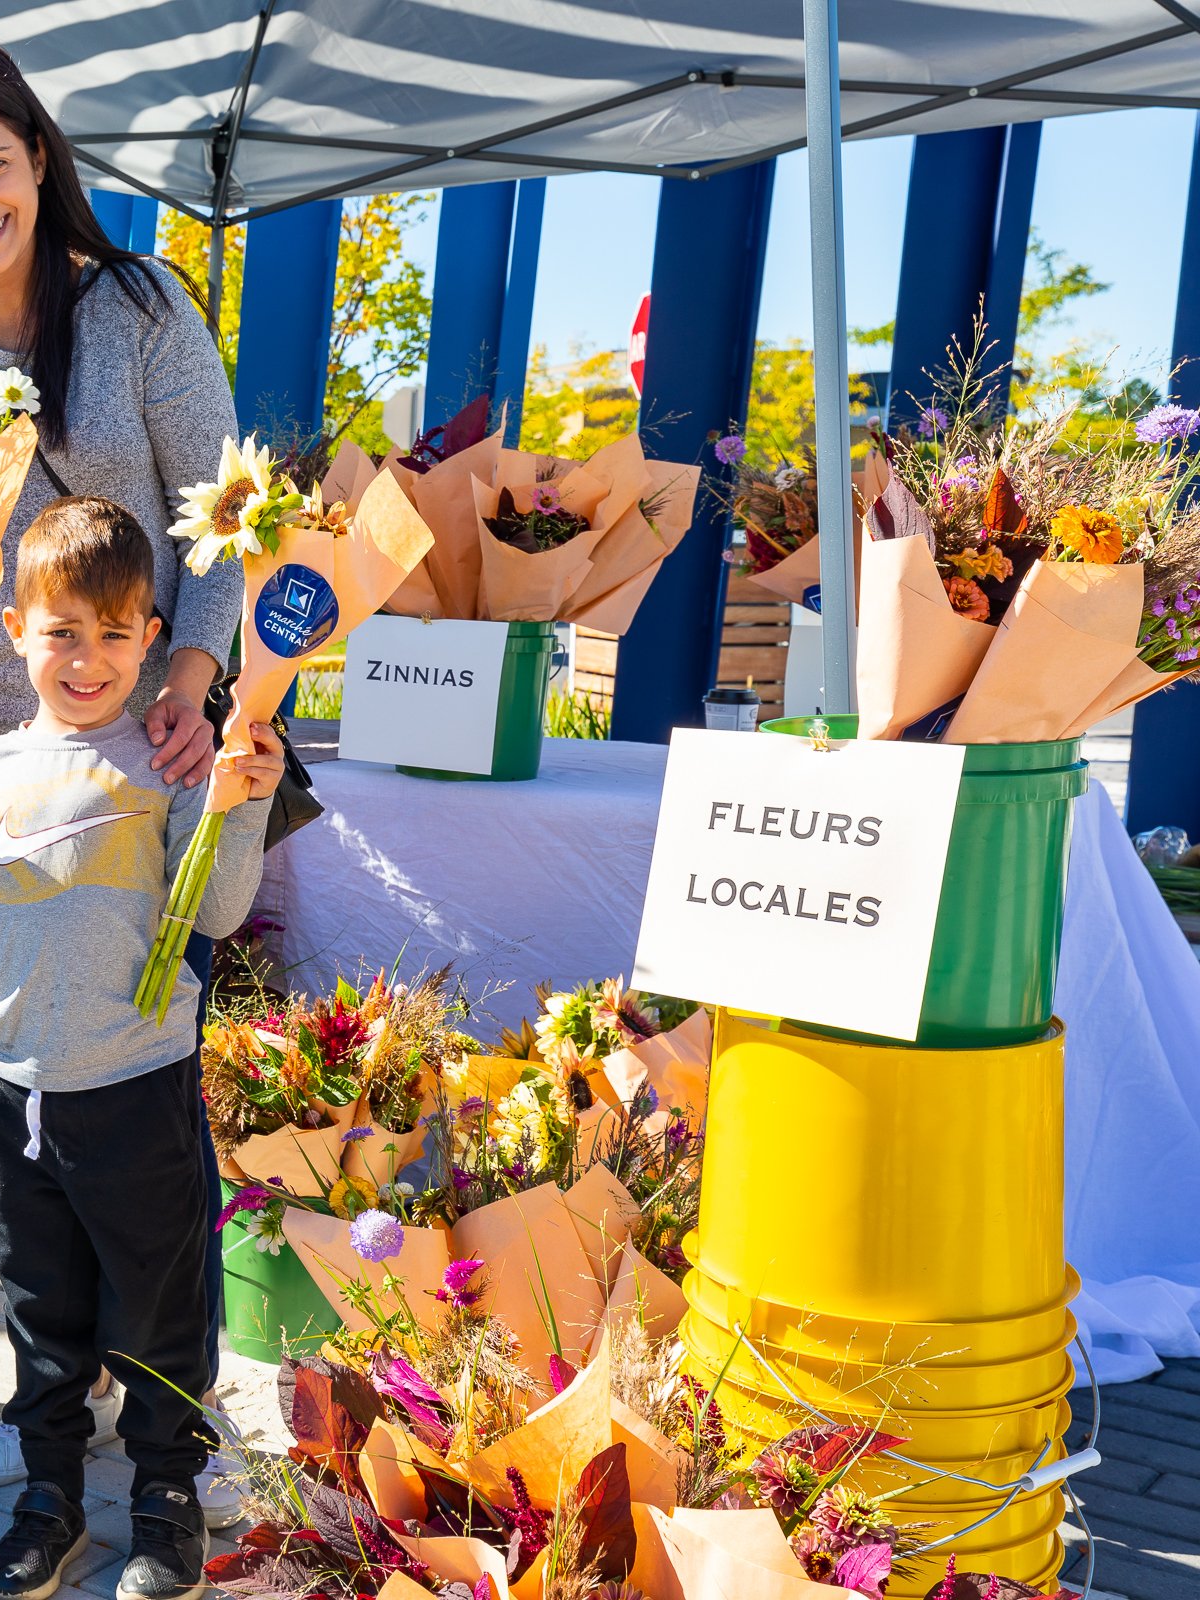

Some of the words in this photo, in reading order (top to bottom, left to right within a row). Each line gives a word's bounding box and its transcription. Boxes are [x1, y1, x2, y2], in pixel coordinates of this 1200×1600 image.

[263, 619, 308, 648] CENTRAL
[268, 609, 313, 636] marché
[366, 659, 474, 688] ZINNIAS
[707, 801, 883, 847] FLEURS
[686, 873, 883, 928] LOCALES
